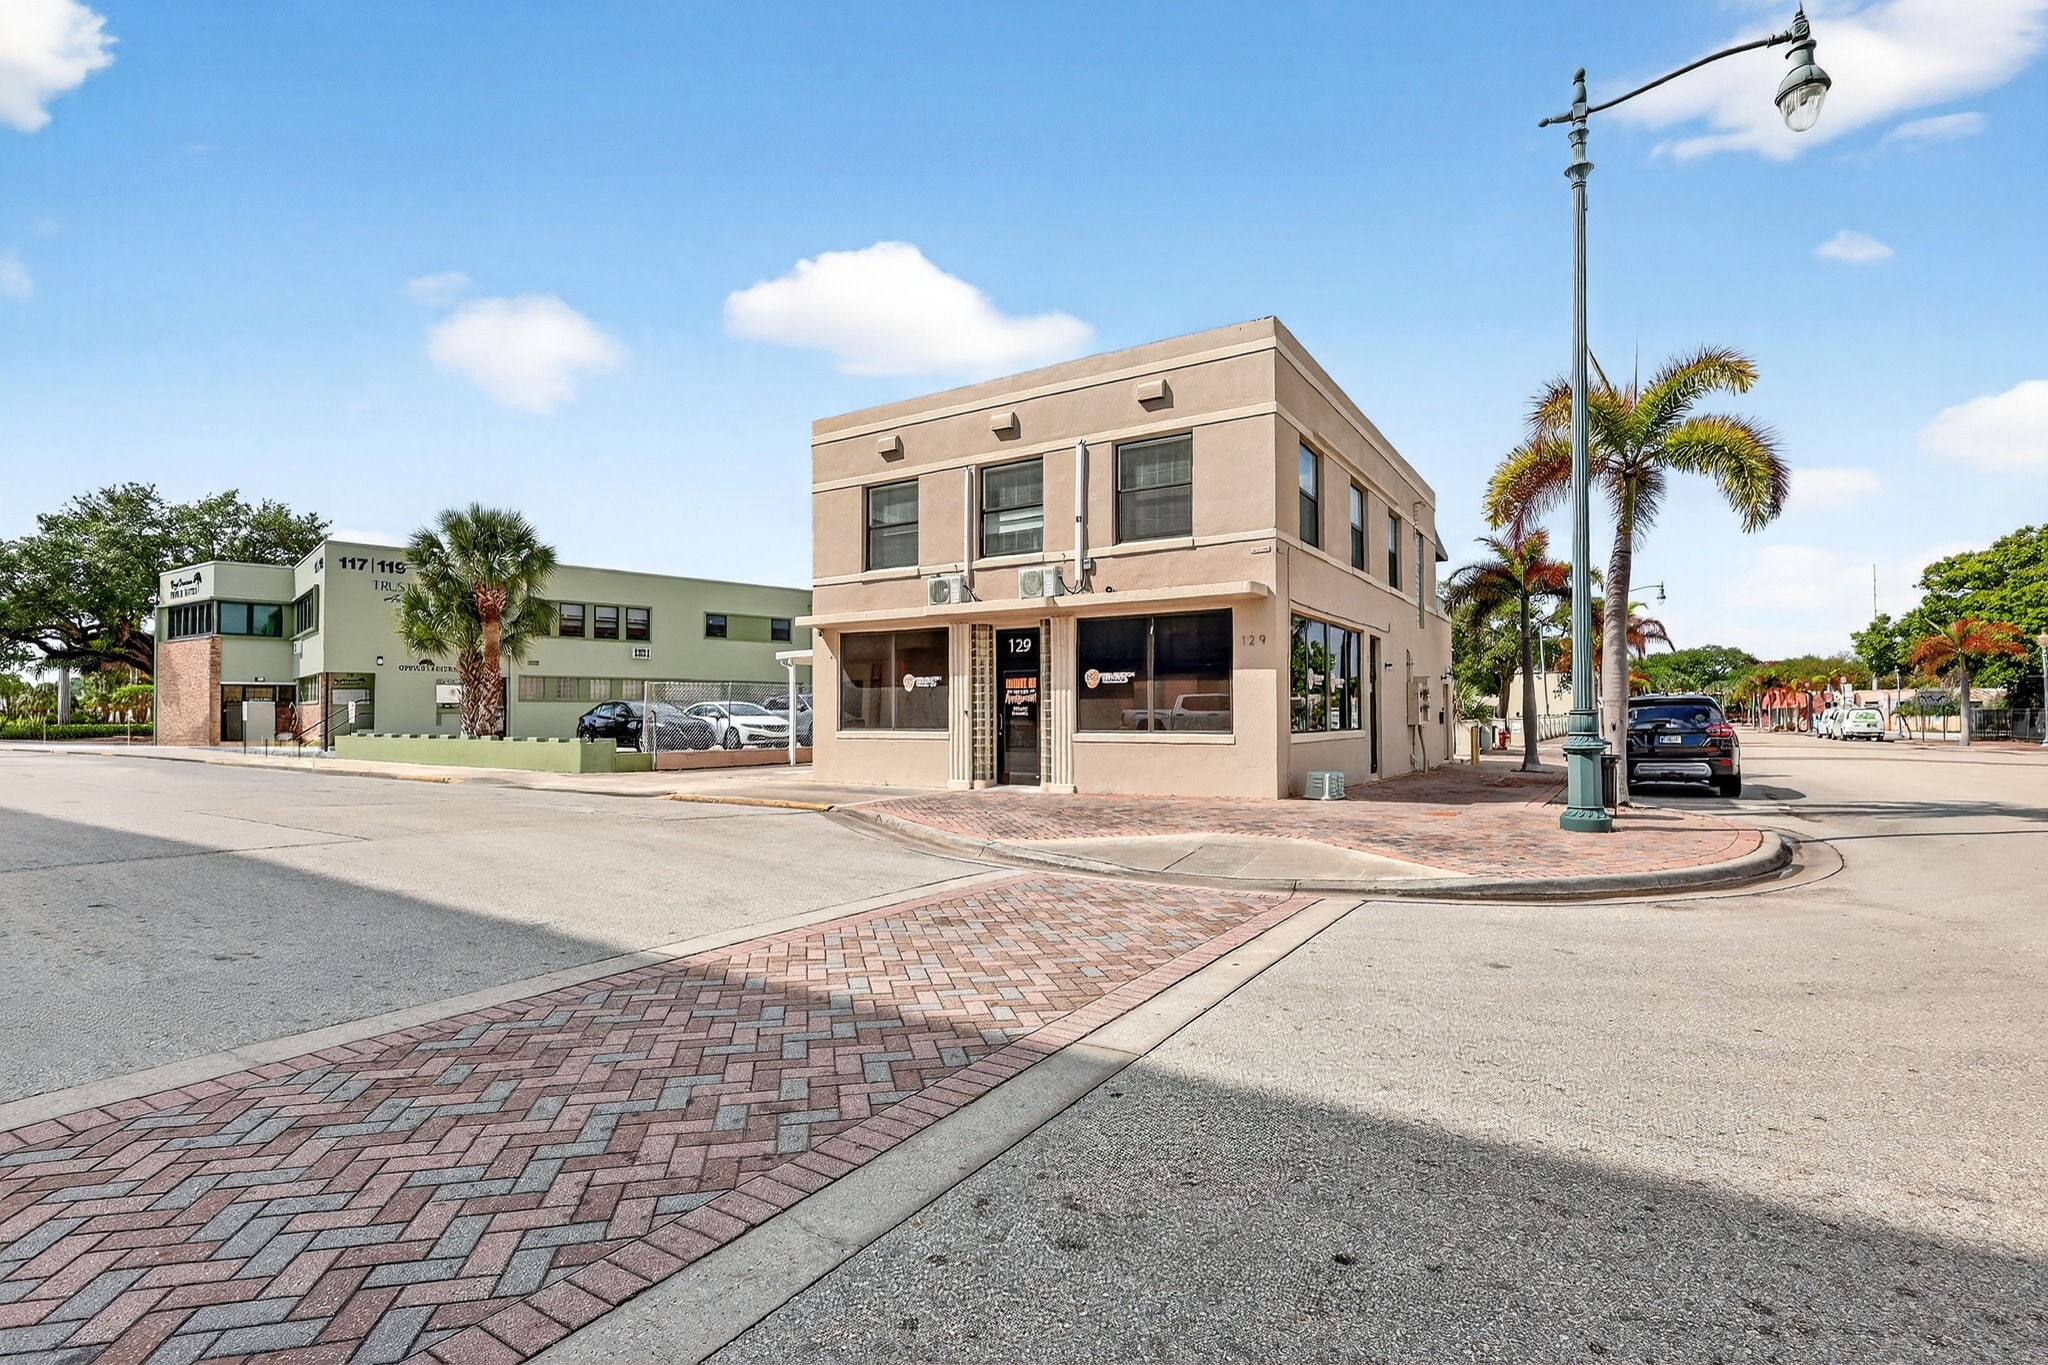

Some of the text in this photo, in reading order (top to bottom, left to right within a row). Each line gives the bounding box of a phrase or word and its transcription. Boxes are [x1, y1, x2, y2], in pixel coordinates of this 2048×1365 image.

[339, 556, 407, 574] 117 119
[1008, 638, 1032, 653] 129
[1242, 634, 1266, 646] 129
